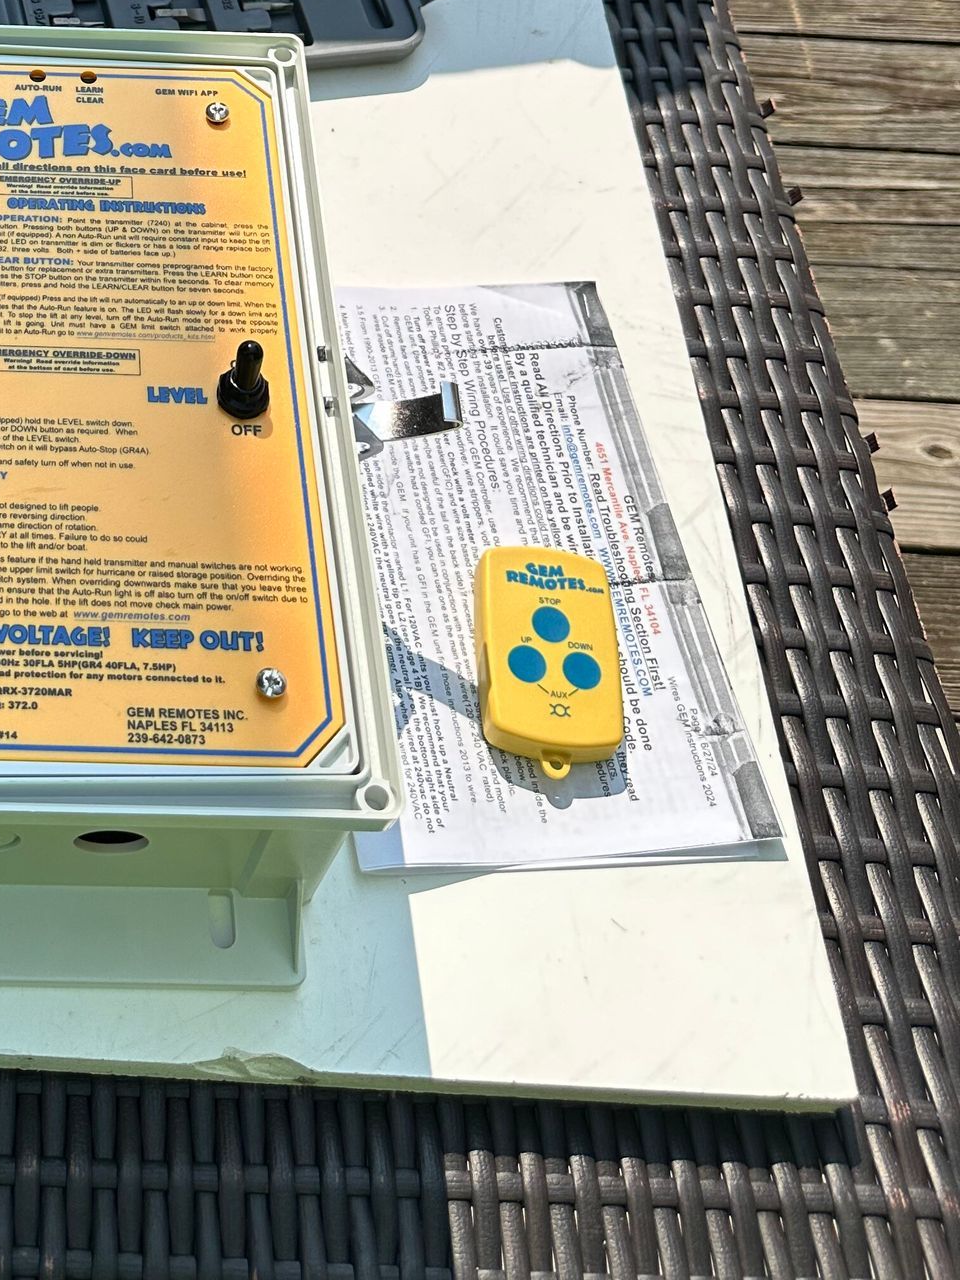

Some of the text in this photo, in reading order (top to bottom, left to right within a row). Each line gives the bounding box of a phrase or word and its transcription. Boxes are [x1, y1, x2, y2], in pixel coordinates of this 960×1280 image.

[13, 163, 72, 172] directions
[94, 165, 116, 174] this
[120, 166, 146, 175] face
[150, 167, 176, 176] card
[180, 168, 217, 177] before
[222, 170, 246, 178] use!
[0, 175, 121, 185] EMERGENCY OVERRIDE-UP
[7, 197, 206, 215] OPERATING INSTRUCTIONS
[24, 257, 74, 266] BUTTON:
[53, 351, 136, 360] OVERRIDE-DOWN
[147, 386, 208, 404] LEVEL
[231, 424, 262, 436] OFF
[522, 379, 559, 490] qualified technician
[542, 401, 574, 491] Directions Prior
[567, 395, 603, 503] Phone Number: Read
[595, 441, 609, 466] 4651
[553, 392, 602, 539] Email: info@gemremotes.com
[602, 467, 623, 520] Mercantile
[624, 495, 638, 524] GEM
[525, 562, 565, 577] GEM
[539, 597, 561, 605] STOP
[640, 587, 651, 603] FL
[74, 612, 190, 622] www.gemremotes.com
[644, 603, 661, 635] 34104
[131, 627, 194, 649] KEEP
[199, 630, 264, 652] OUT!
[521, 636, 532, 644] UP
[568, 641, 593, 651] DOWN
[19, 648, 51, 657] before
[54, 649, 103, 659] servicing!
[630, 607, 667, 691] Section First!
[23, 659, 55, 667] 30FLA
[58, 660, 103, 670] 5HP(GR4
[106, 661, 140, 670] 40FLA,
[143, 663, 176, 672] 7.5HP)
[14, 670, 66, 680] protection
[70, 671, 83, 679] for
[86, 673, 104, 681] any
[107, 673, 142, 681] motors
[146, 674, 198, 683] connected
[215, 676, 226, 684] it.
[550, 690, 568, 698] AUX
[8, 701, 38, 710] 372.0
[127, 707, 248, 720] GEM REMOTES INC.
[127, 720, 234, 733] NAPLES FL 34113
[128, 733, 206, 745] 239-642-0873
